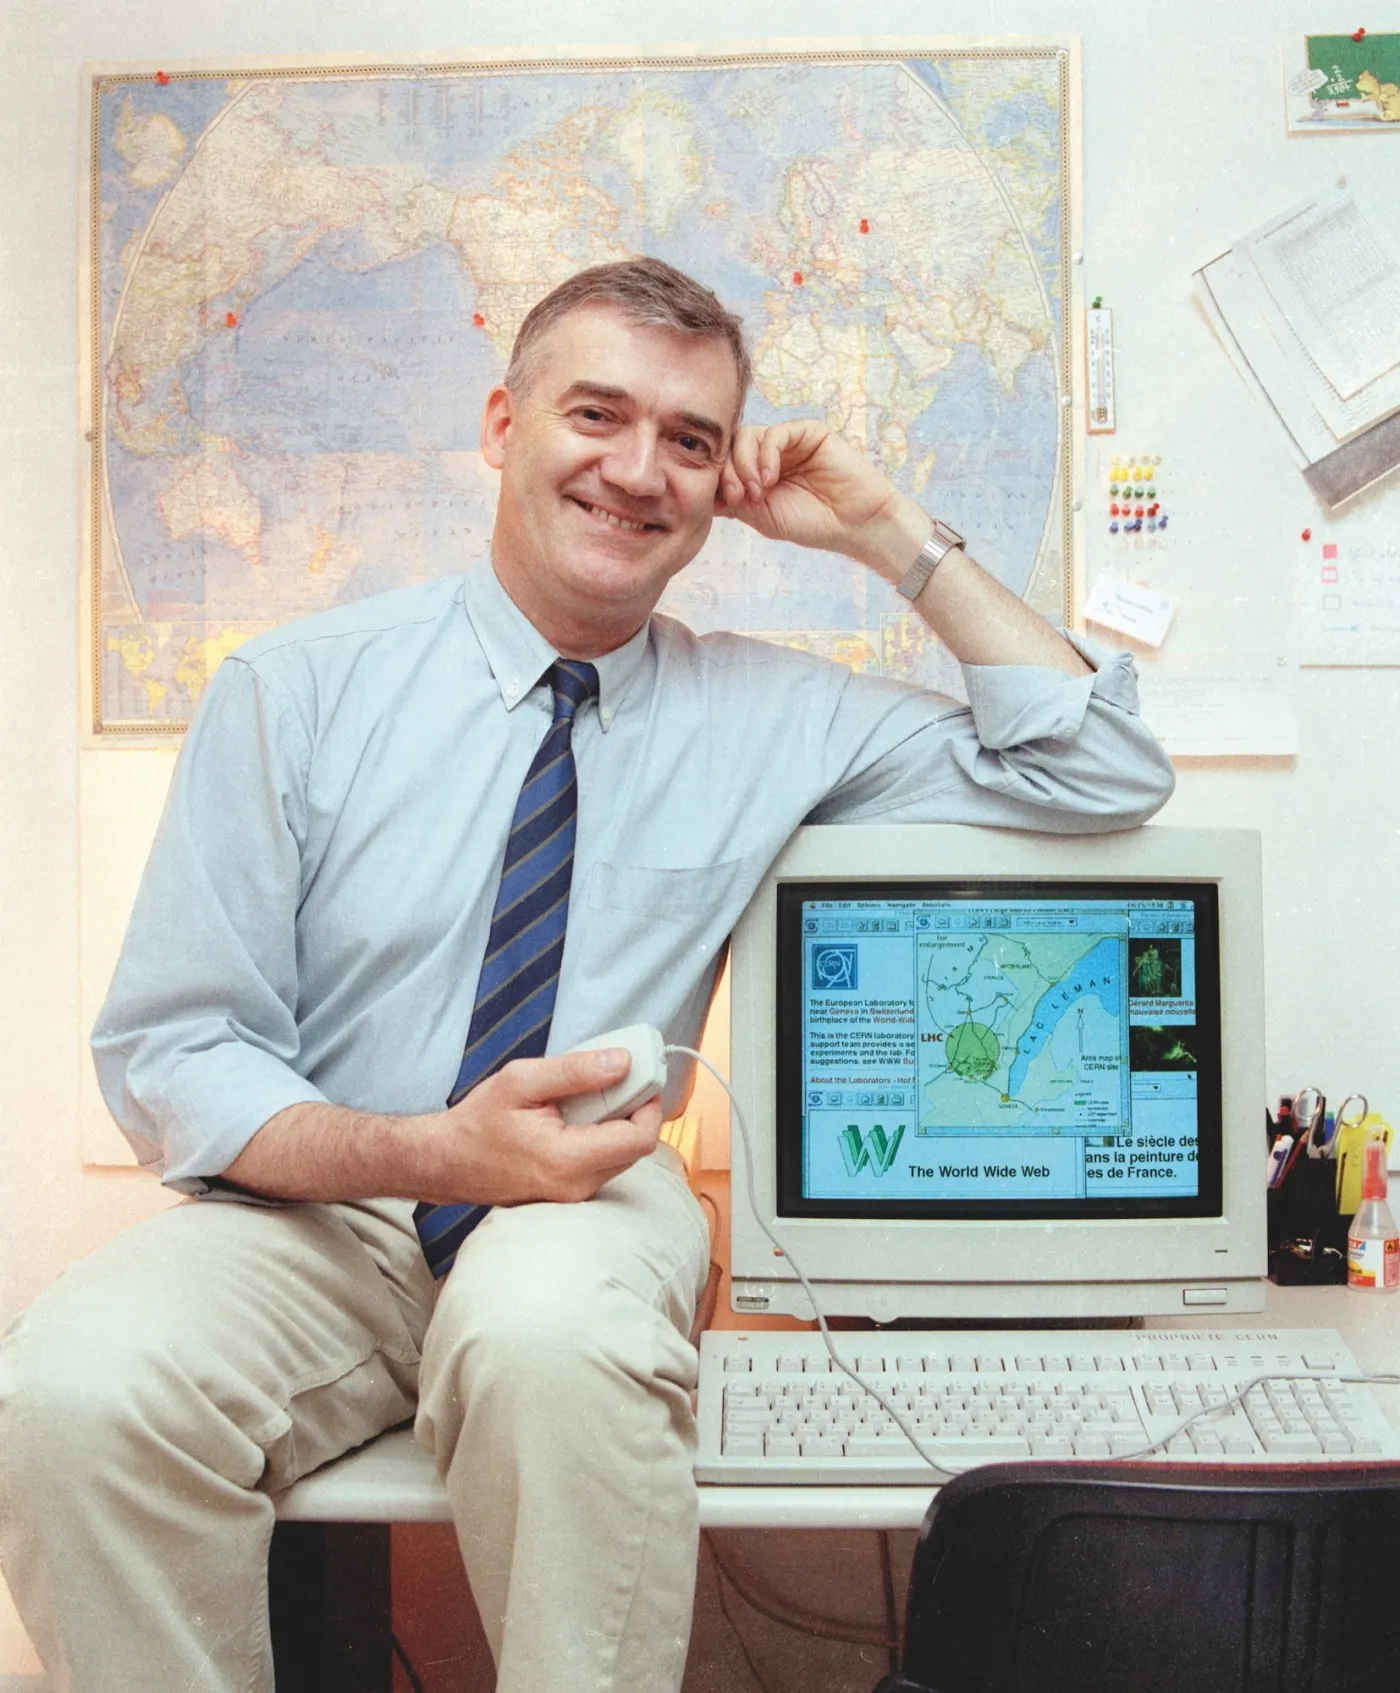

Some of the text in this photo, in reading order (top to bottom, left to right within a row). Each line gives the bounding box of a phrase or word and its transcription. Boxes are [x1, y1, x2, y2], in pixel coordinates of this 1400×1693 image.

[919, 941, 966, 950] enlargement
[810, 999, 824, 1007] The
[825, 999, 863, 1010] European
[865, 999, 907, 1010] Laboratory
[810, 1016, 849, 1026] birthplace
[849, 1016, 858, 1024] of
[859, 1016, 871, 1024] the
[810, 1031, 915, 1041] This is the CERN laboratory
[920, 1033, 944, 1043] LHC
[810, 1041, 840, 1049] support
[862, 1041, 897, 1049] provides
[810, 1049, 857, 1058] experiments
[1098, 1055, 1114, 1063] map
[1084, 1063, 1106, 1071] CERN
[810, 1076, 833, 1084] About
[834, 1076, 847, 1084] the
[848, 1076, 891, 1086] Laboratory
[1116, 1136, 1133, 1148] Le
[1137, 1135, 1176, 1147] siècle
[1085, 1153, 1110, 1164] ans
[1114, 1151, 1126, 1163] la
[1129, 1151, 1184, 1165] peinture
[908, 1165, 1051, 1178] The World Wide Web
[1087, 1166, 1177, 1179] es de France.
[1235, 1332, 1278, 1341] CERN
